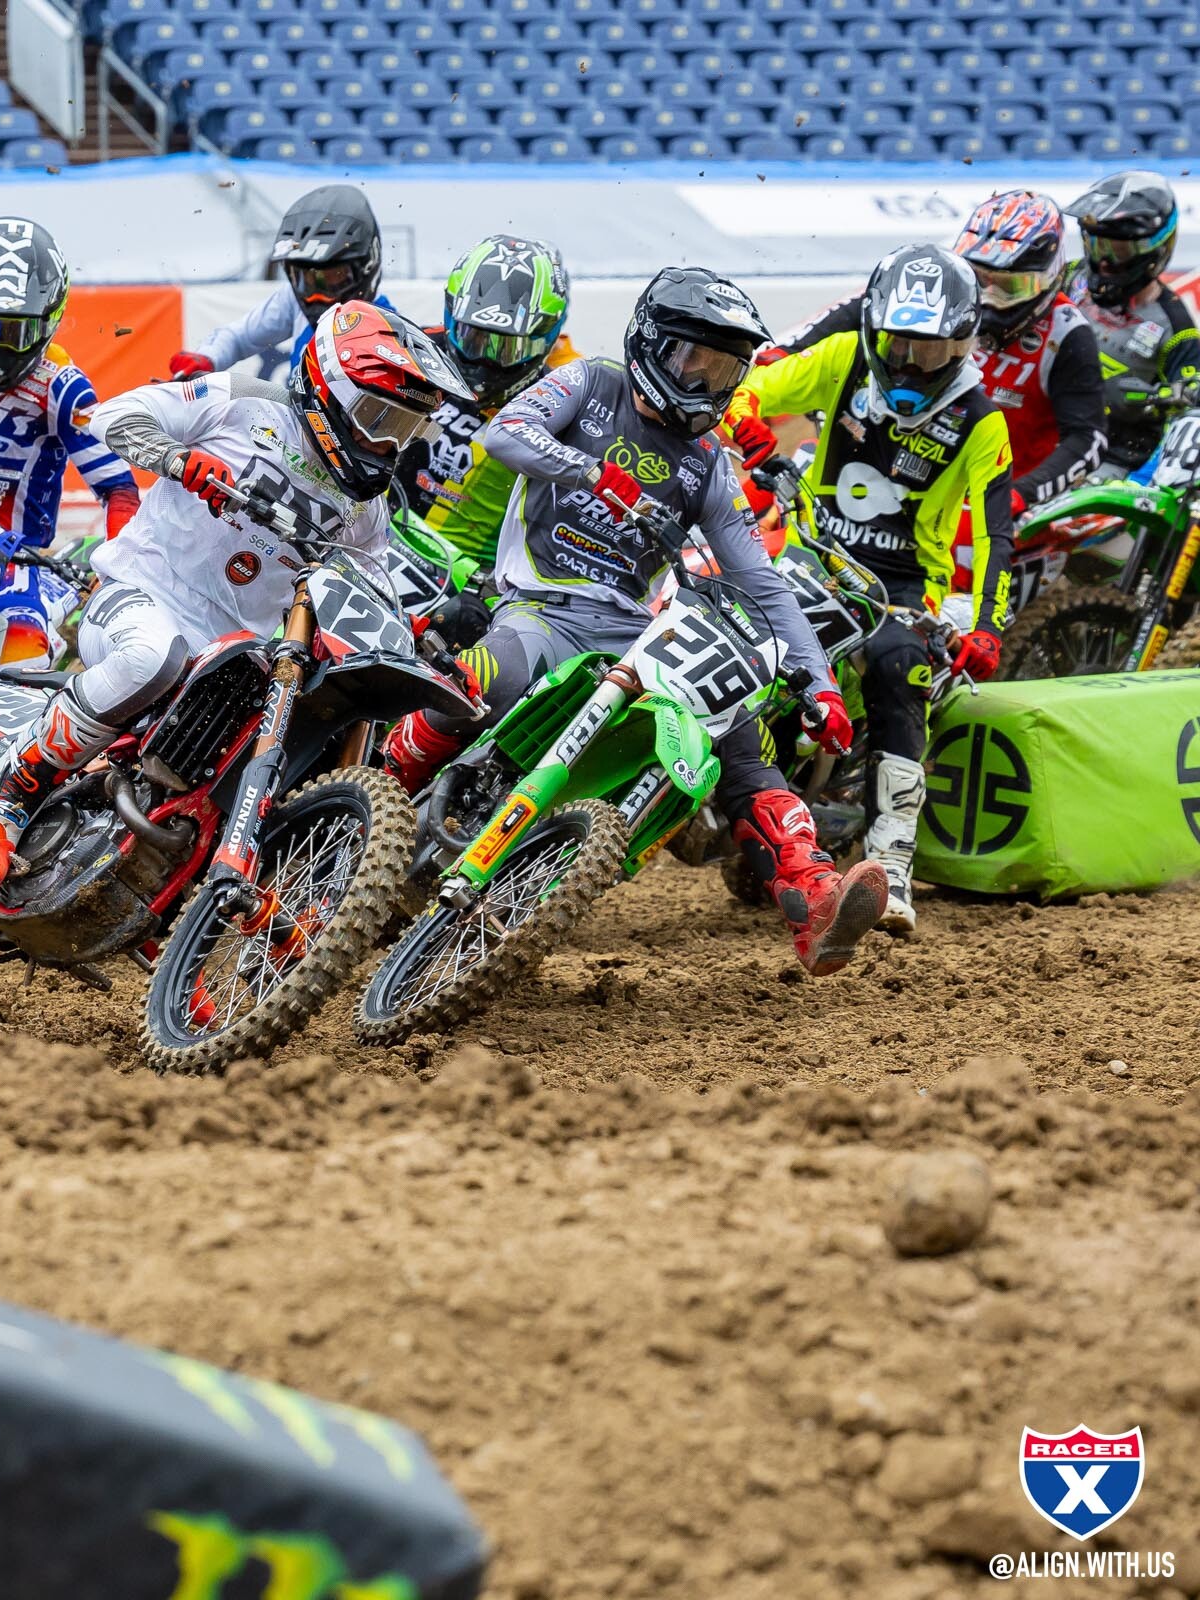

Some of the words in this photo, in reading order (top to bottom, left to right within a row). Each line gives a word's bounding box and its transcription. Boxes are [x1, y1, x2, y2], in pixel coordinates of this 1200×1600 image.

[471, 304, 513, 327] 6D
[586, 398, 615, 423] FIST
[249, 424, 265, 438] FAST
[519, 423, 585, 466] PARTZILL
[290, 464, 318, 485] SUPPORT
[557, 488, 645, 548] PRMX
[579, 517, 623, 543] RACING
[249, 533, 276, 558] sera
[643, 613, 758, 716] 219
[275, 703, 293, 742] racing
[228, 784, 259, 856] DUNLOP
